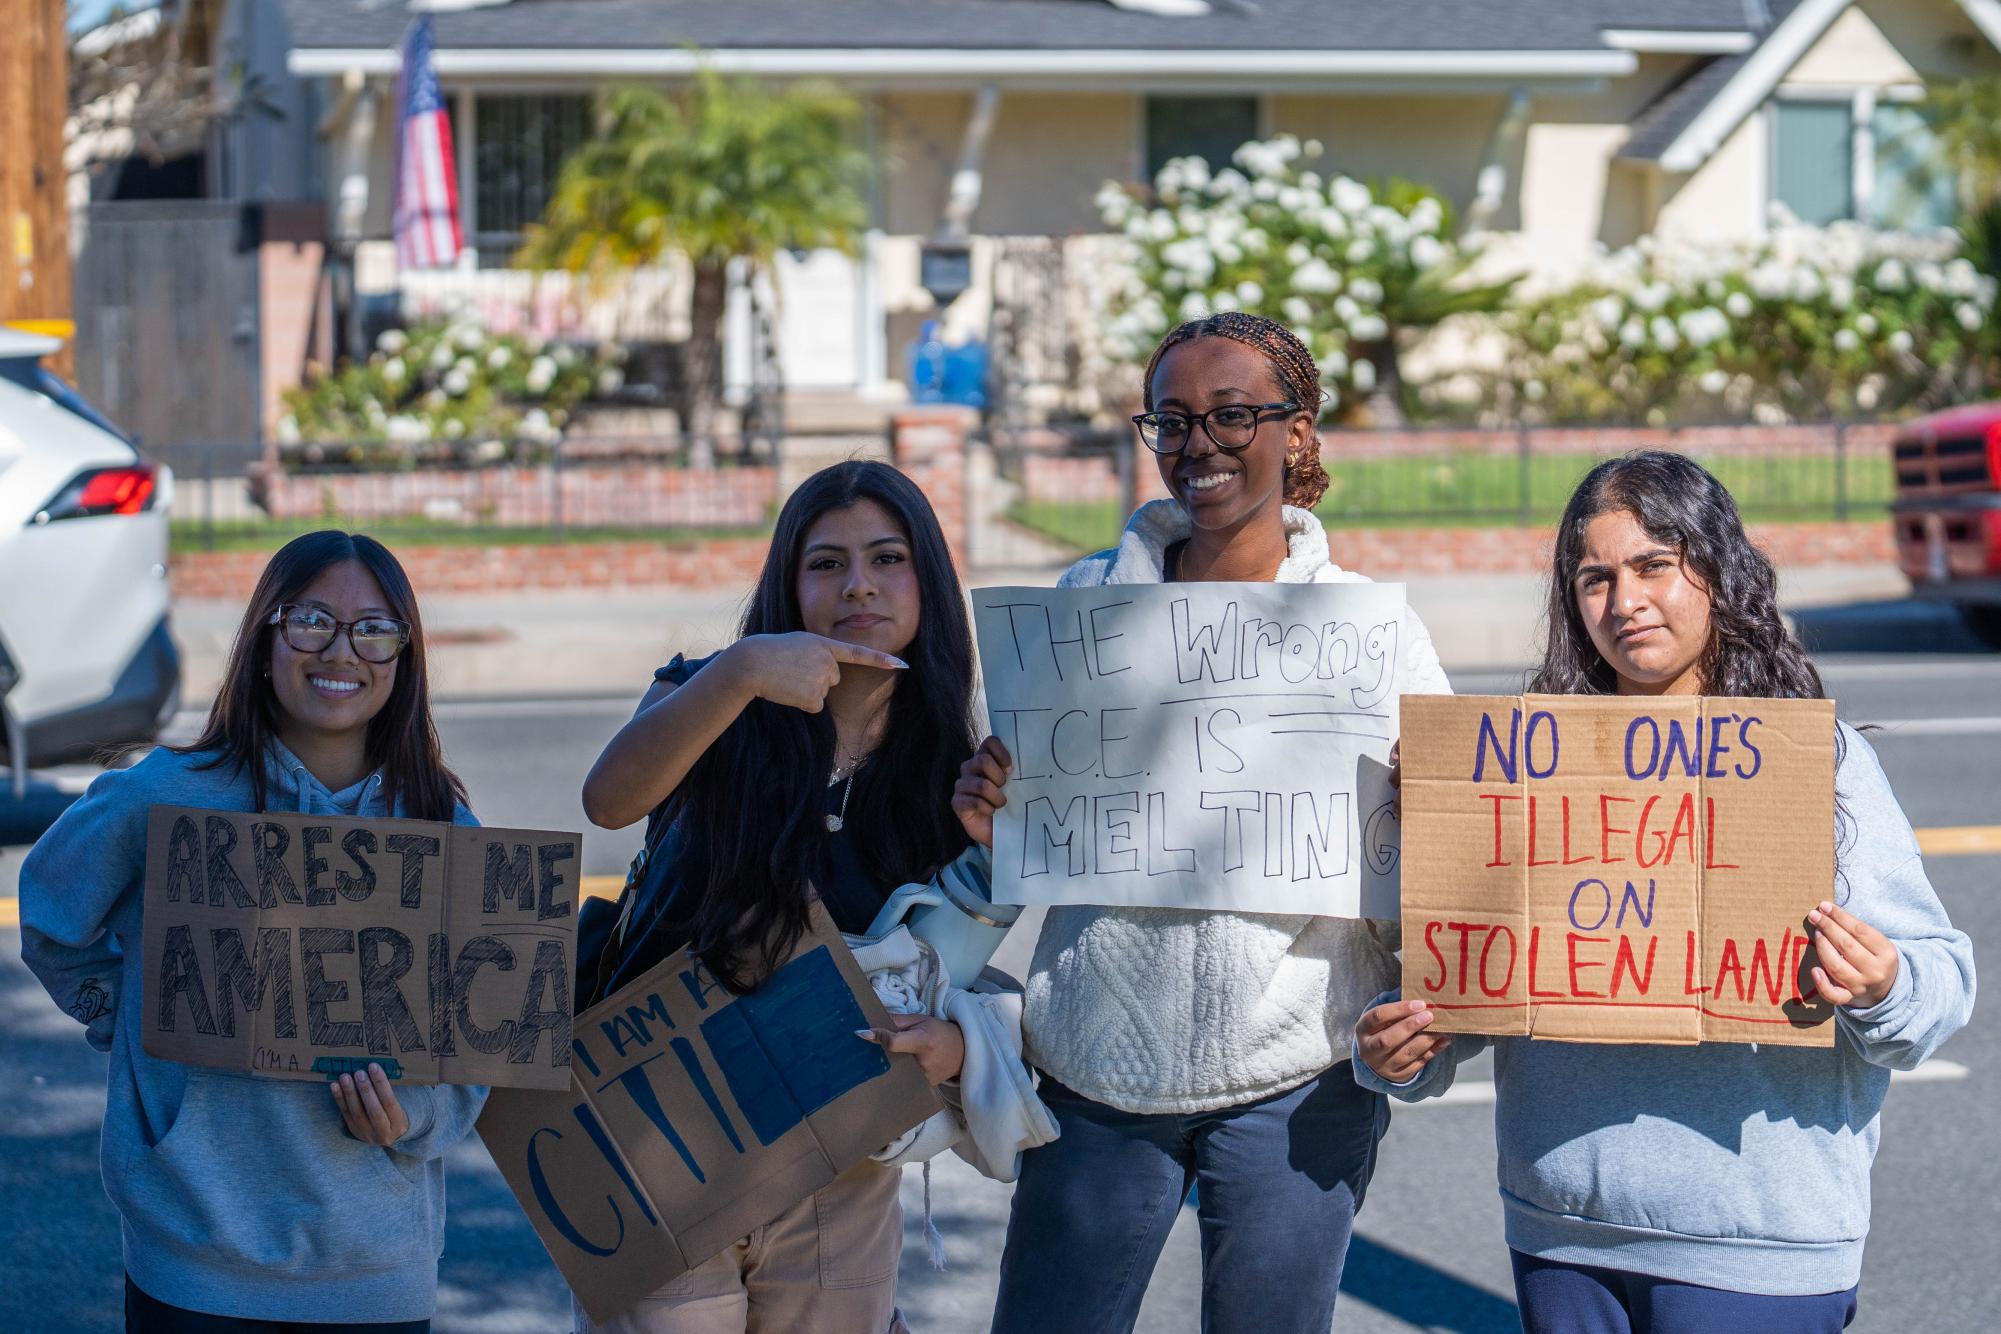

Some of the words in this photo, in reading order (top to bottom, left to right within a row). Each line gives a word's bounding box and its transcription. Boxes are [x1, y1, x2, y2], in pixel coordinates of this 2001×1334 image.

[985, 601, 1133, 681] THE
[1170, 598, 1398, 709] Wrong
[993, 707, 1151, 781] I.C.E.
[1194, 708, 1244, 774] IS
[1472, 708, 1559, 784] NO
[1624, 713, 1762, 781] ONE'S
[166, 815, 441, 909] ARREST
[482, 842, 575, 921] ME
[1021, 791, 1400, 882] MELTING
[1479, 792, 1740, 869] ILLEGAL
[1568, 878, 1655, 931] ON
[158, 925, 573, 1068] AMERICA
[1424, 921, 1659, 999] STOLEN
[572, 1038, 600, 1067] I
[600, 993, 676, 1057] AM
